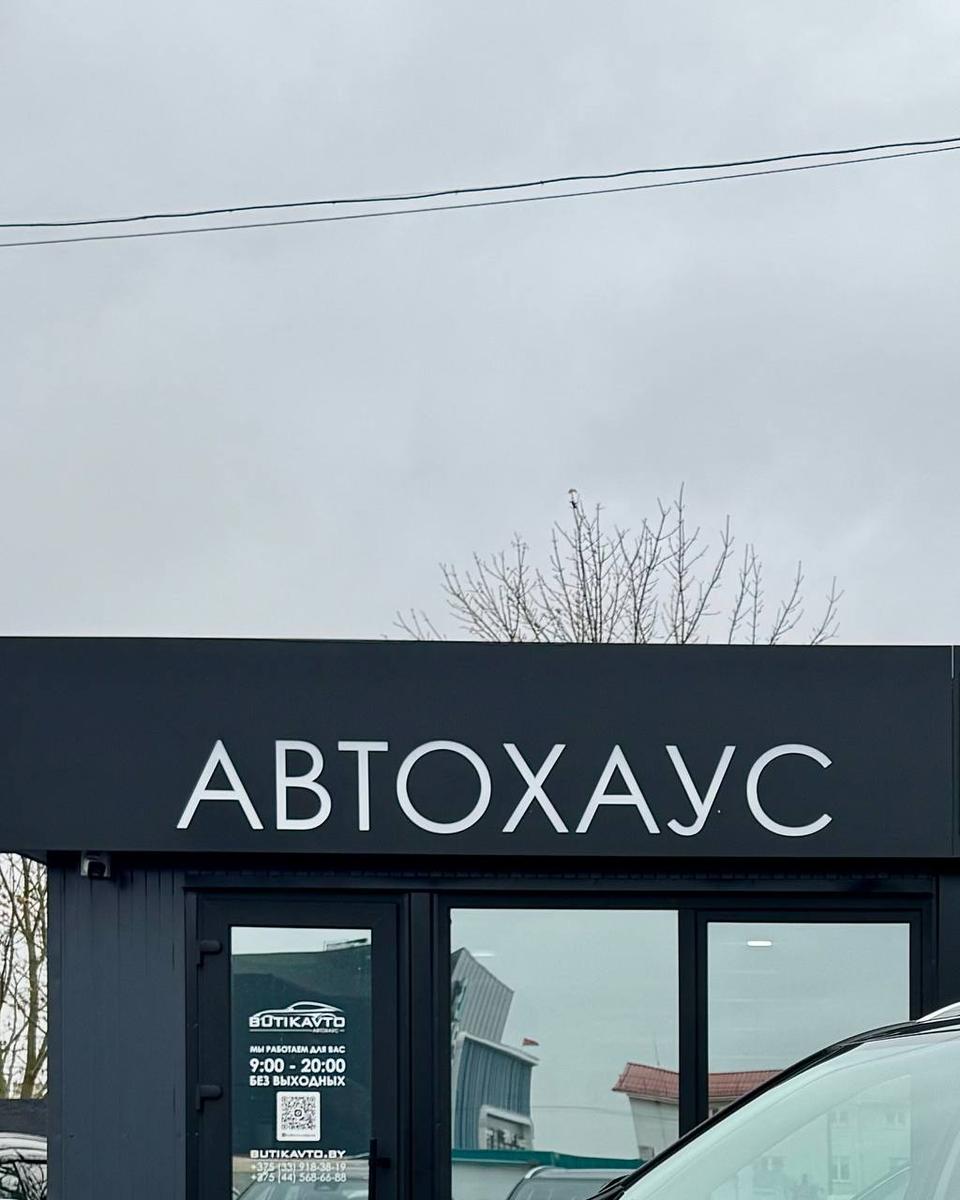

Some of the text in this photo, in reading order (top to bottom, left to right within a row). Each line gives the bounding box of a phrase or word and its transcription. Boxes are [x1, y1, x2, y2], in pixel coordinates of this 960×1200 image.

[177, 740, 832, 836] АВТОХАУС
[249, 1015, 346, 1028] BUTIKAVTO
[249, 1045, 346, 1055] МЫ РАБОТАЕМ ДЛЯ ВАС
[249, 1058, 285, 1073] 9:00
[300, 1058, 346, 1073] 20:00
[249, 1075, 346, 1088] БЕЗ ВЫХОДНЫХ
[250, 1149, 347, 1159] BUTIKAVTO.BY
